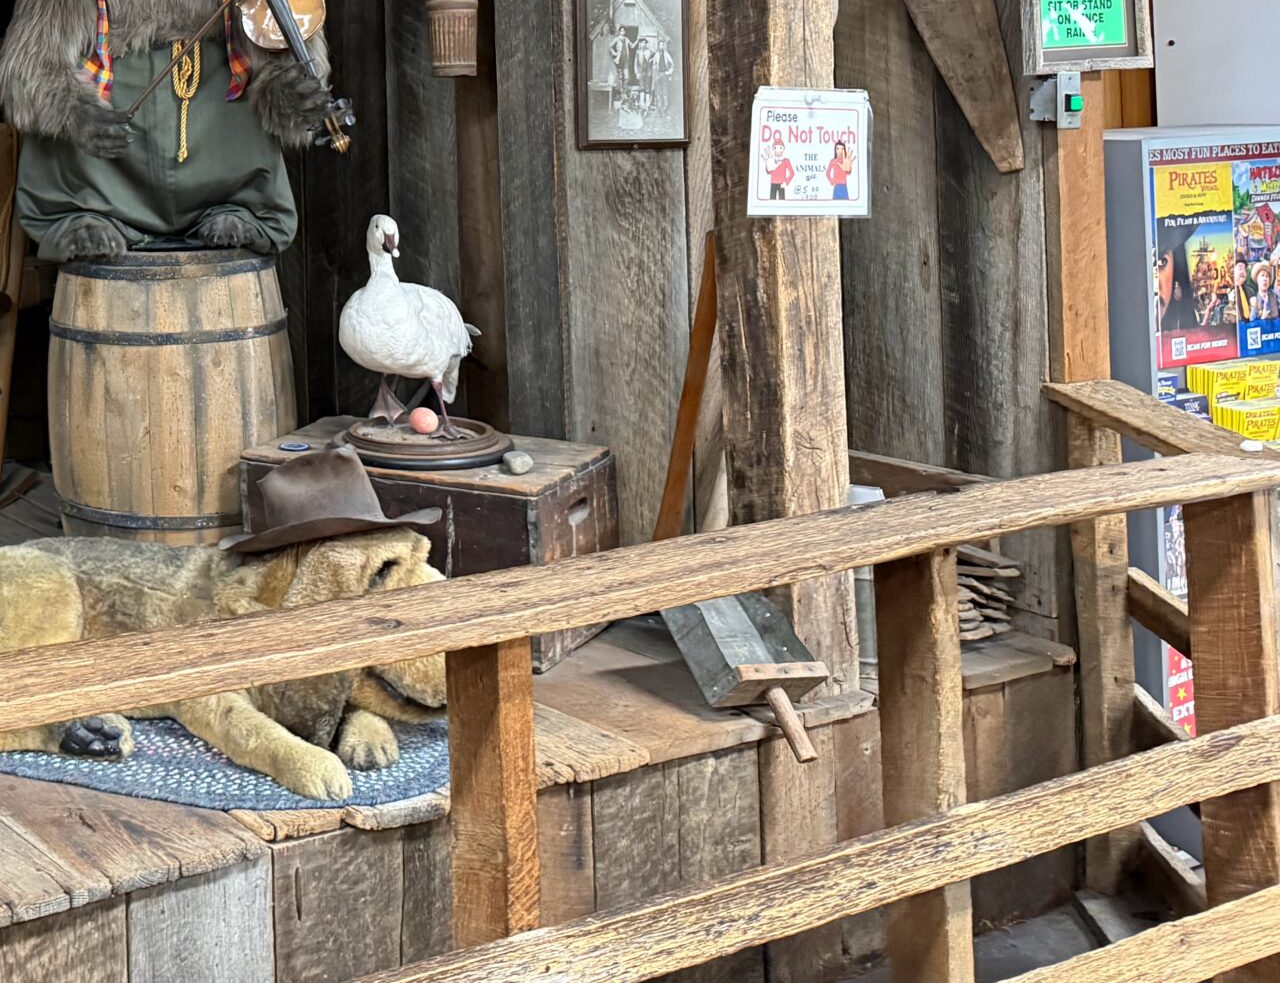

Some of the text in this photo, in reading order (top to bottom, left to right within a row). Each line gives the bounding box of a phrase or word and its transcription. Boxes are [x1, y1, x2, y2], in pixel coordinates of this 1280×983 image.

[1081, 0, 1112, 10] STAND
[1057, 14, 1071, 25] ON
[766, 110, 798, 123] Please
[761, 125, 856, 144] Do Not Touch
[804, 153, 818, 161] THE
[1163, 148, 1190, 160] MOST
[1191, 147, 1210, 159] FUN
[1212, 144, 1247, 158] PLACES
[1248, 143, 1260, 155] TO
[795, 164, 826, 173] ANIMALS
[1168, 169, 1218, 191] PIRATES
[1215, 370, 1247, 383] PIRATES
[1246, 418, 1277, 431] PIRATES
